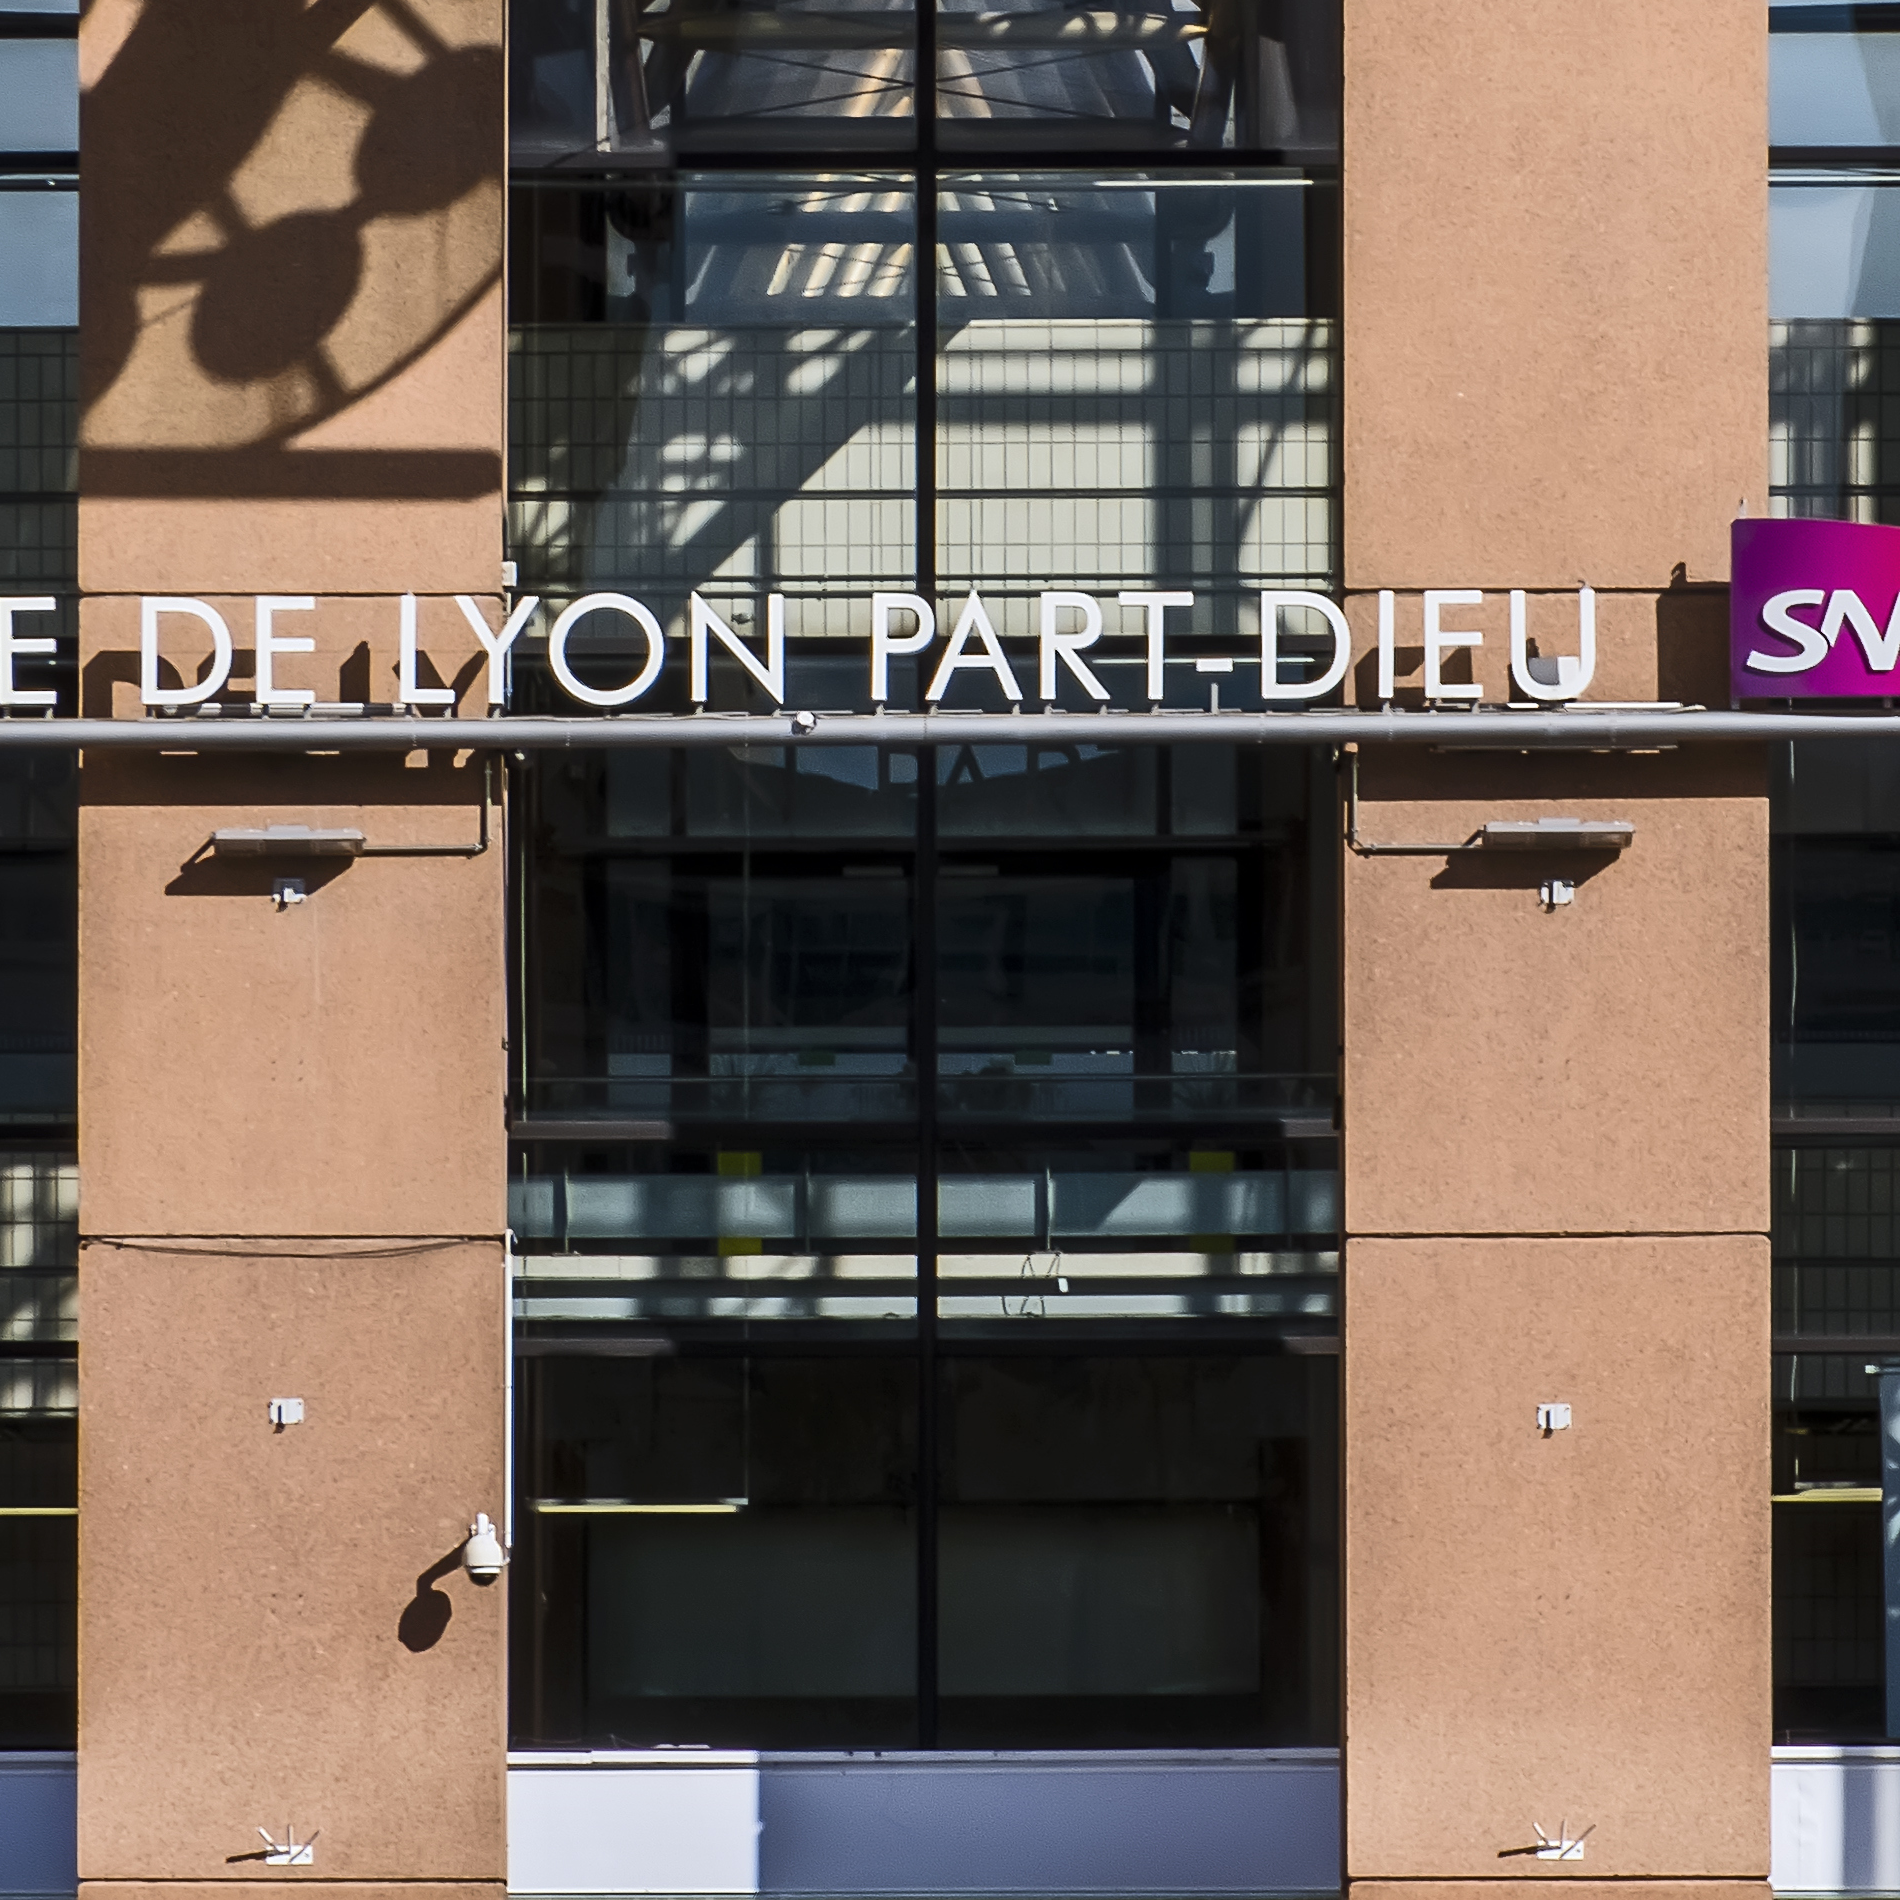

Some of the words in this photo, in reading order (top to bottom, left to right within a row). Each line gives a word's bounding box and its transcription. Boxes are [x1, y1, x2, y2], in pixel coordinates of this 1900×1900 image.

[140, 593, 316, 704] DE
[393, 592, 786, 707] LYON
[870, 586, 1597, 706] PART-DIEU
